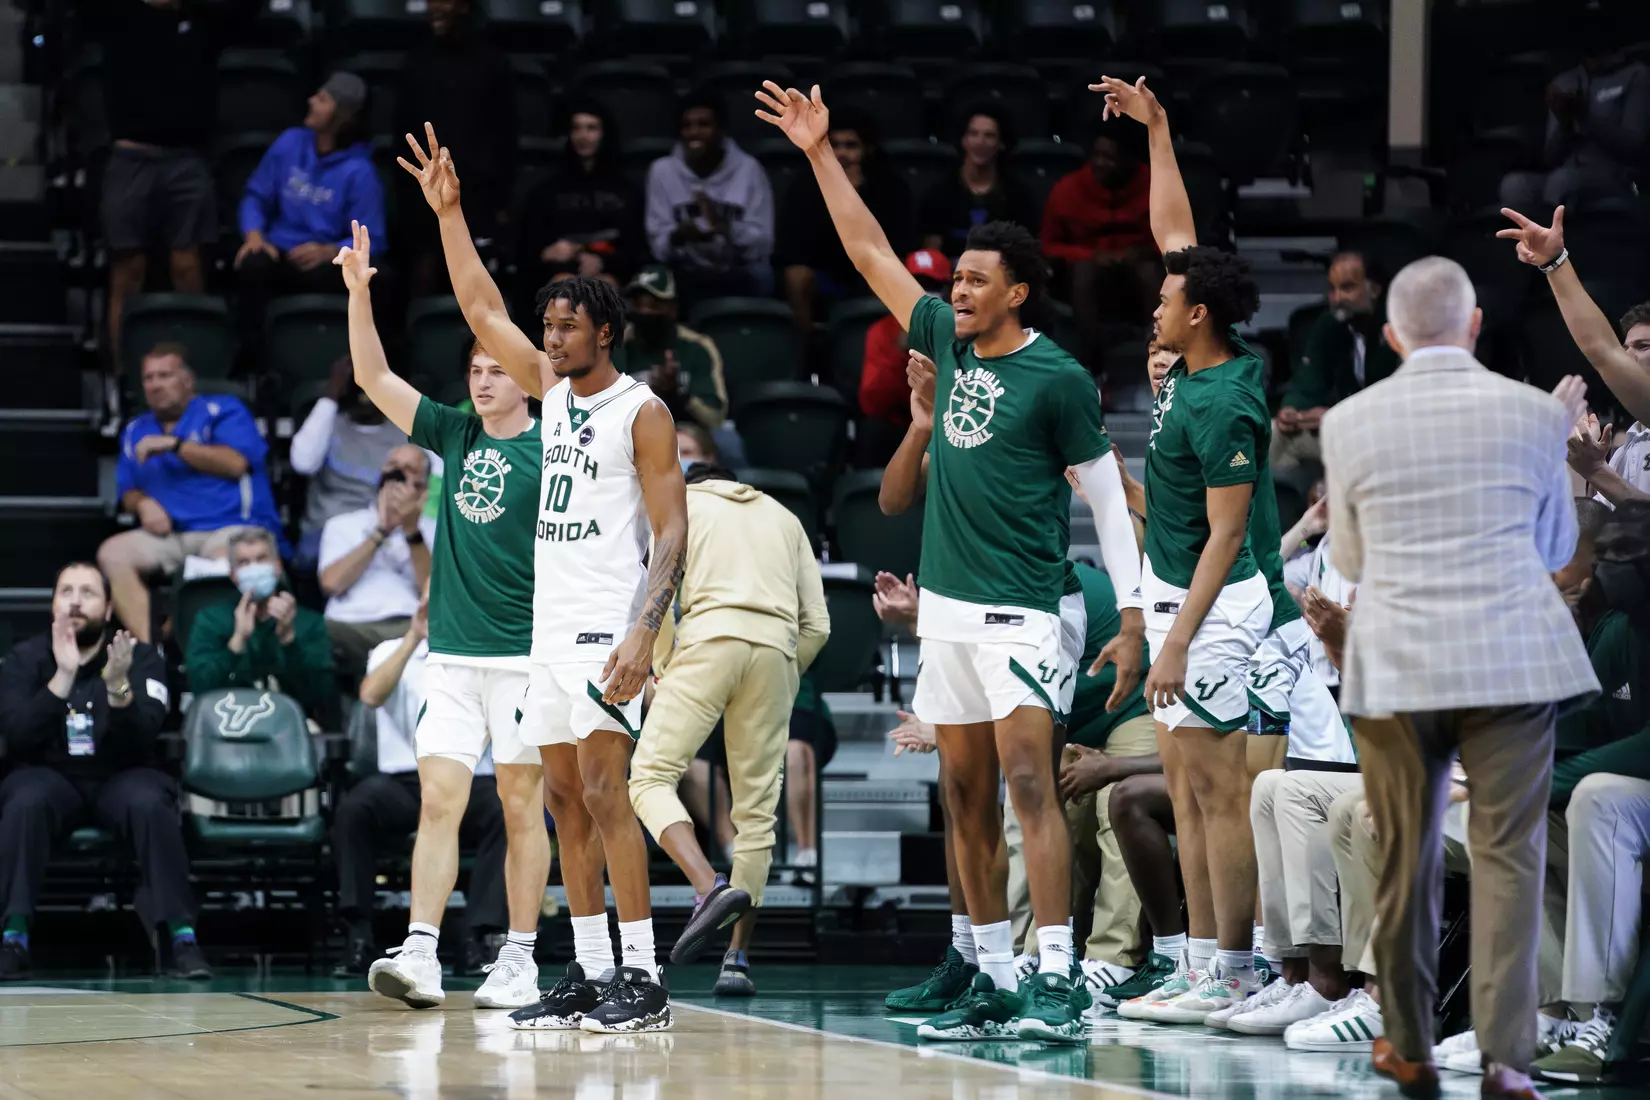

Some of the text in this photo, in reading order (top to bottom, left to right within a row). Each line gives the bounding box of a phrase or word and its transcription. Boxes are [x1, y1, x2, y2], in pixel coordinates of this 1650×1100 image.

[974, 368, 1005, 398] BULLS
[464, 448, 512, 474] USF BULLS
[543, 444, 599, 481] SOUTH
[454, 491, 506, 524] BASKETBALL
[545, 473, 573, 513] 10
[537, 519, 602, 542] ORIDA
